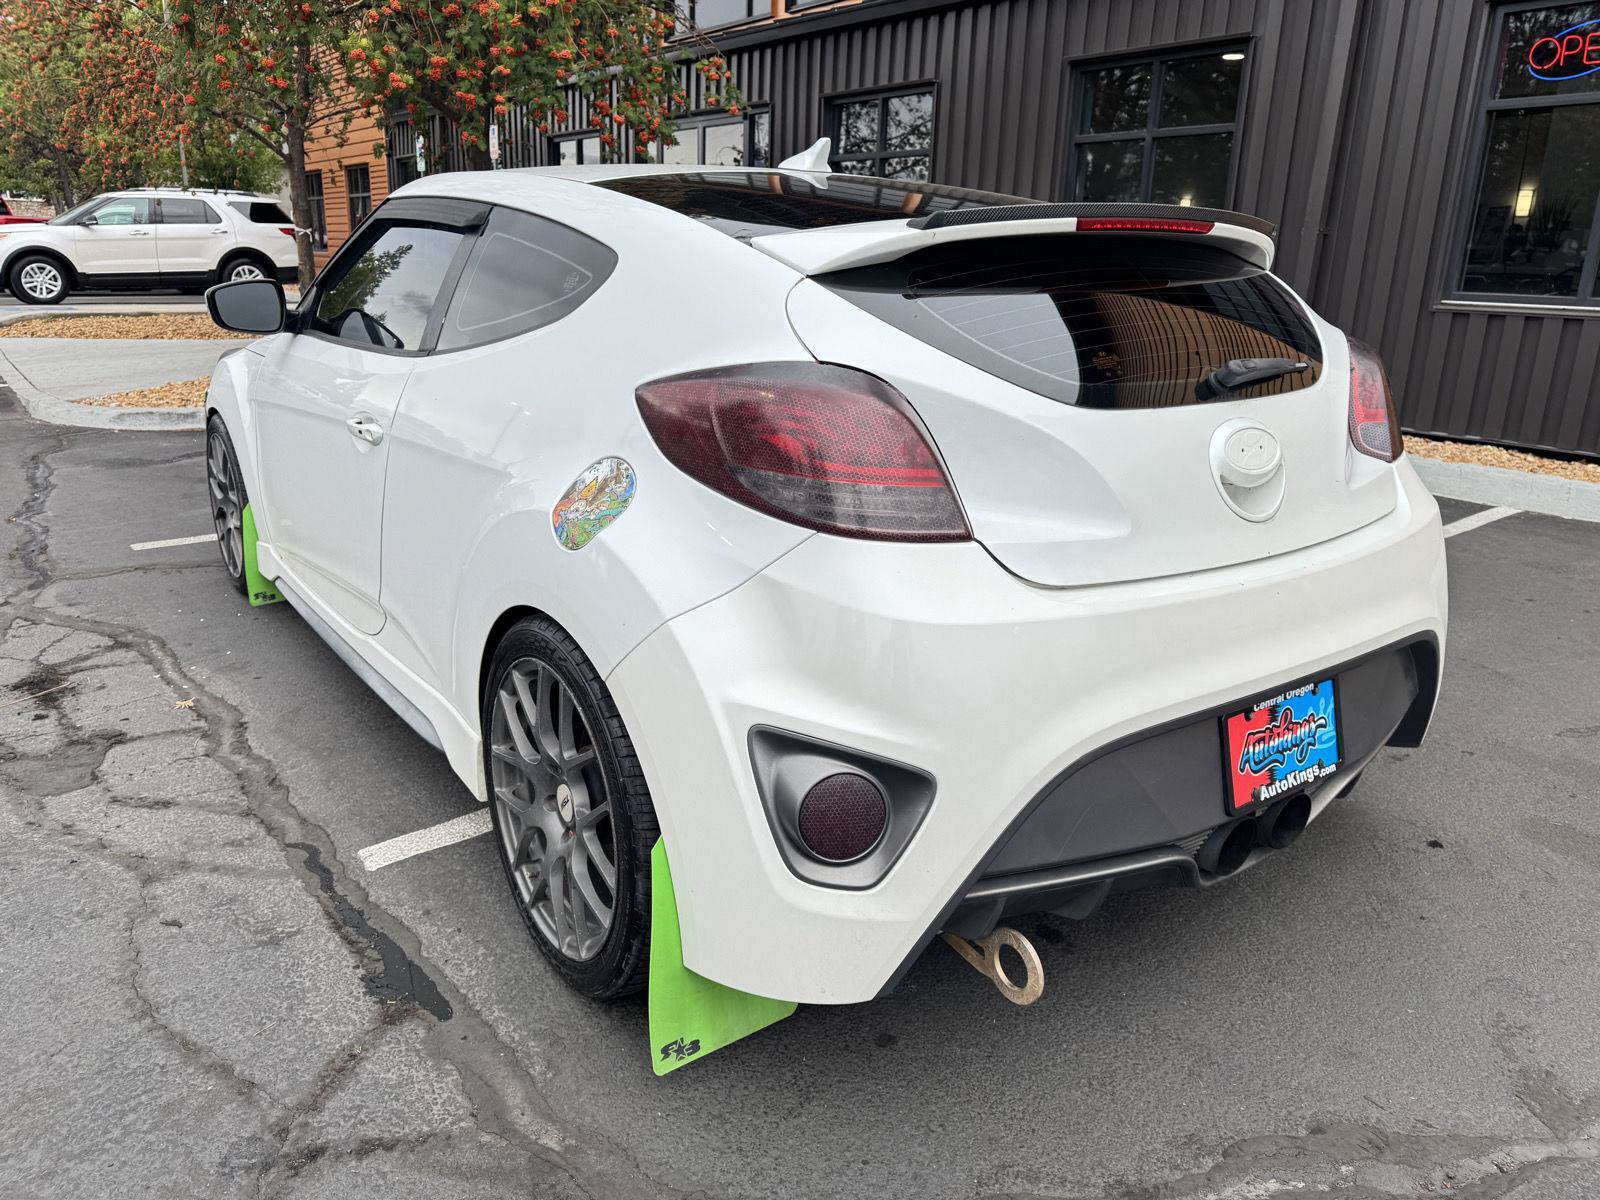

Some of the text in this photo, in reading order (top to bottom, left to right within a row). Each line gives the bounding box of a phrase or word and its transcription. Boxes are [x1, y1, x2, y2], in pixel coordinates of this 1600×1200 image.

[1253, 682, 1315, 712] Central Oregon
[1260, 763, 1337, 801] AutoKings.com
